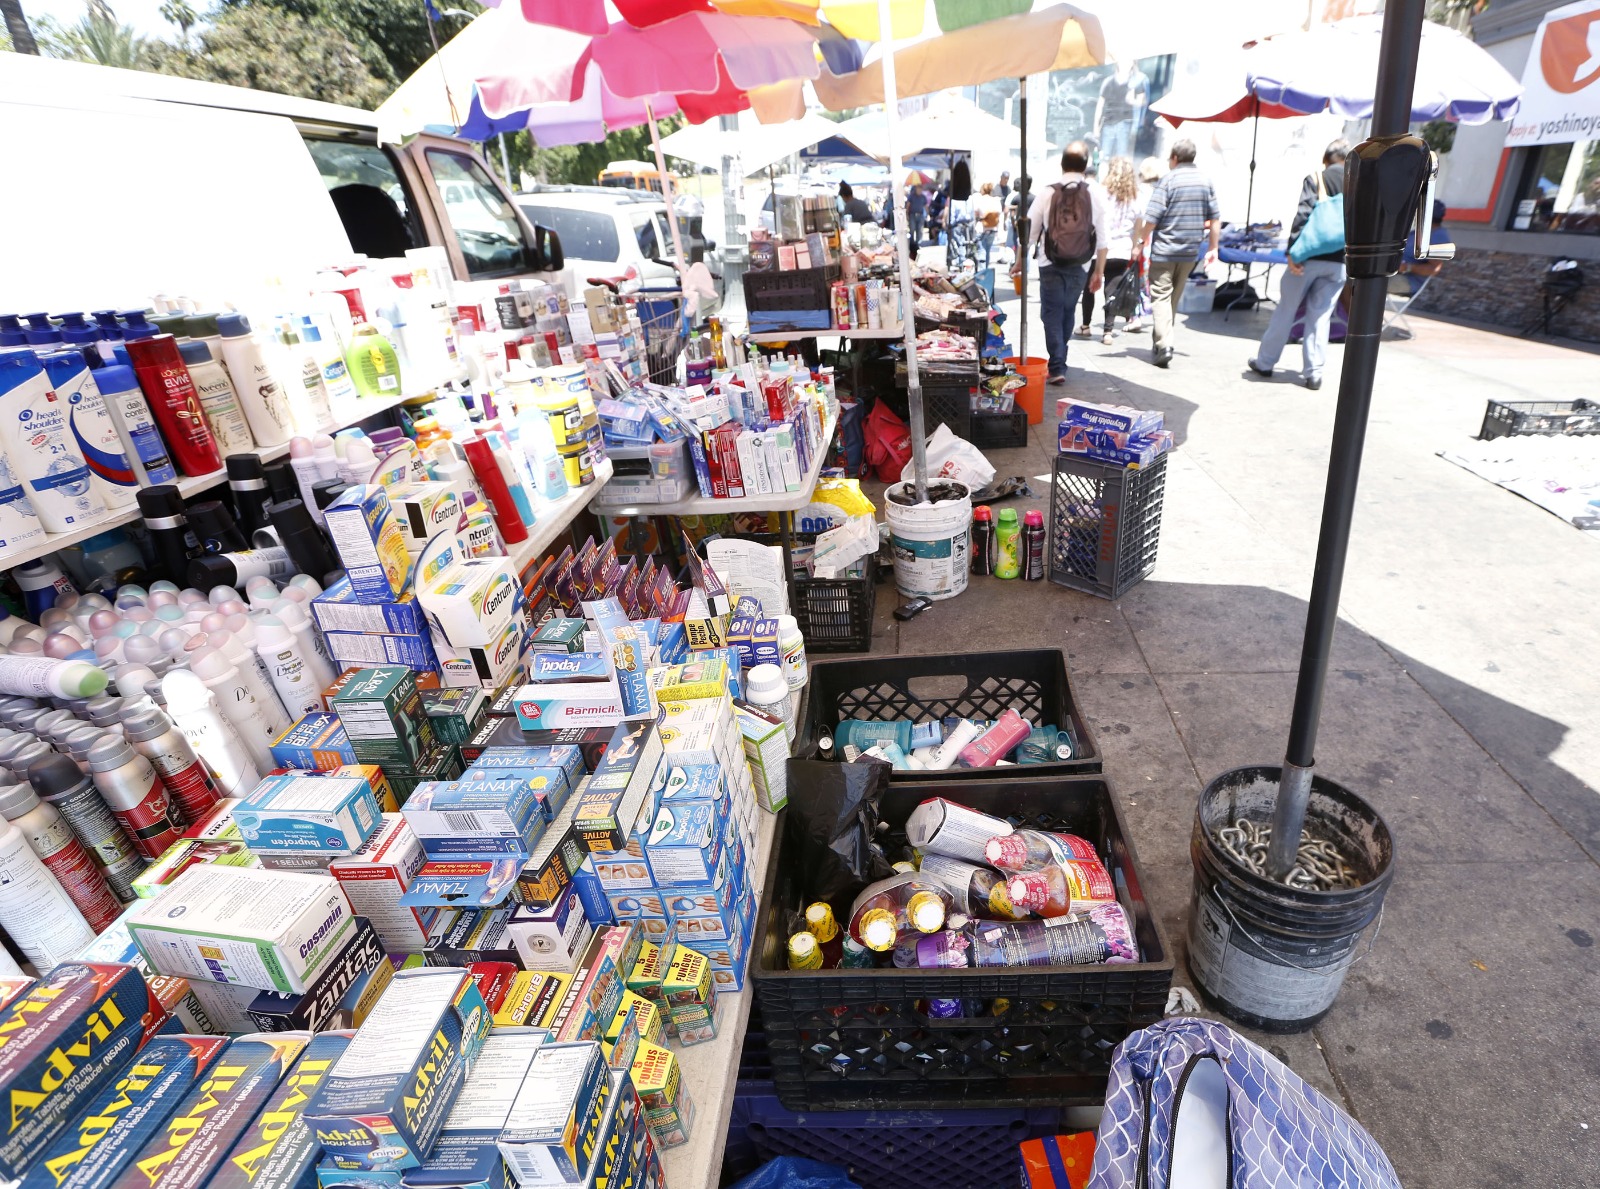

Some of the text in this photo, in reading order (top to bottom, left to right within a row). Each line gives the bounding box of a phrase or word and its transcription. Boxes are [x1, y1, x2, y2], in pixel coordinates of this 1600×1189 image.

[164, 374, 190, 388] ELVIVE
[198, 381, 228, 393] Aveeno
[126, 400, 142, 409] daily
[24, 416, 65, 432] shoulders
[1082, 411, 1127, 430] Reynolds Wrap
[434, 502, 458, 524] Centrum
[469, 524, 494, 542] ntrum
[486, 582, 513, 615] Centrum
[689, 623, 698, 646] Rompe
[698, 625, 707, 645] Pecho
[497, 632, 520, 665] Centrum
[446, 663, 472, 671] Centrum
[541, 661, 580, 674] Pepcid
[398, 677, 414, 699] RAY
[632, 672, 648, 712] FLANAX
[565, 706, 615, 716] Barmicil
[283, 724, 308, 744] Osteo
[292, 714, 331, 746] Bi-Flex
[471, 718, 500, 746] BENGAY
[479, 757, 528, 766] FLANAX
[458, 782, 517, 792] FLANAX
[582, 792, 622, 802] ACTIVE
[271, 838, 321, 846] Ibuprofen
[582, 831, 610, 839] ACTIVE
[551, 854, 569, 885] ACTIVE
[411, 883, 468, 893] FLANAX
[299, 904, 342, 959] Cosamin
[450, 910, 478, 949] PROSTATE
[305, 947, 319, 966] ASU
[316, 925, 371, 997] MAXIMUM STRENGTH
[363, 951, 381, 975] 150
[641, 948, 659, 978] FUNGUS
[676, 953, 693, 981] FUNGUS
[686, 956, 703, 983] FIGHTERS
[103, 966, 127, 987] Tablets
[303, 934, 375, 1032] Zantac
[530, 978, 559, 1026] Ginseng Power
[145, 1014, 166, 1037] Tablets
[182, 994, 222, 1036] XCEDRIN
[461, 1012, 481, 1047] minis
[201, 1039, 222, 1061] Tablets
[7, 997, 126, 1135] Advil
[75, 1064, 103, 1093] Reducer
[103, 1036, 130, 1066] (NSAID)
[638, 1049, 658, 1085] FUNGUS
[650, 1051, 669, 1085] FIGHTERS
[403, 1029, 450, 1129] Advil
[126, 1099, 154, 1128] Reducer
[152, 1071, 182, 1099] (NSAID)
[409, 1047, 455, 1135] LIQUI-GELS
[44, 1064, 166, 1188] Advil
[136, 1064, 248, 1188] Advil
[214, 1102, 240, 1130] Reducer
[232, 1058, 333, 1182] Advil
[316, 1128, 369, 1142] Advil
[321, 1139, 374, 1147] LIQUI-GELS
[372, 1147, 402, 1159] minis
